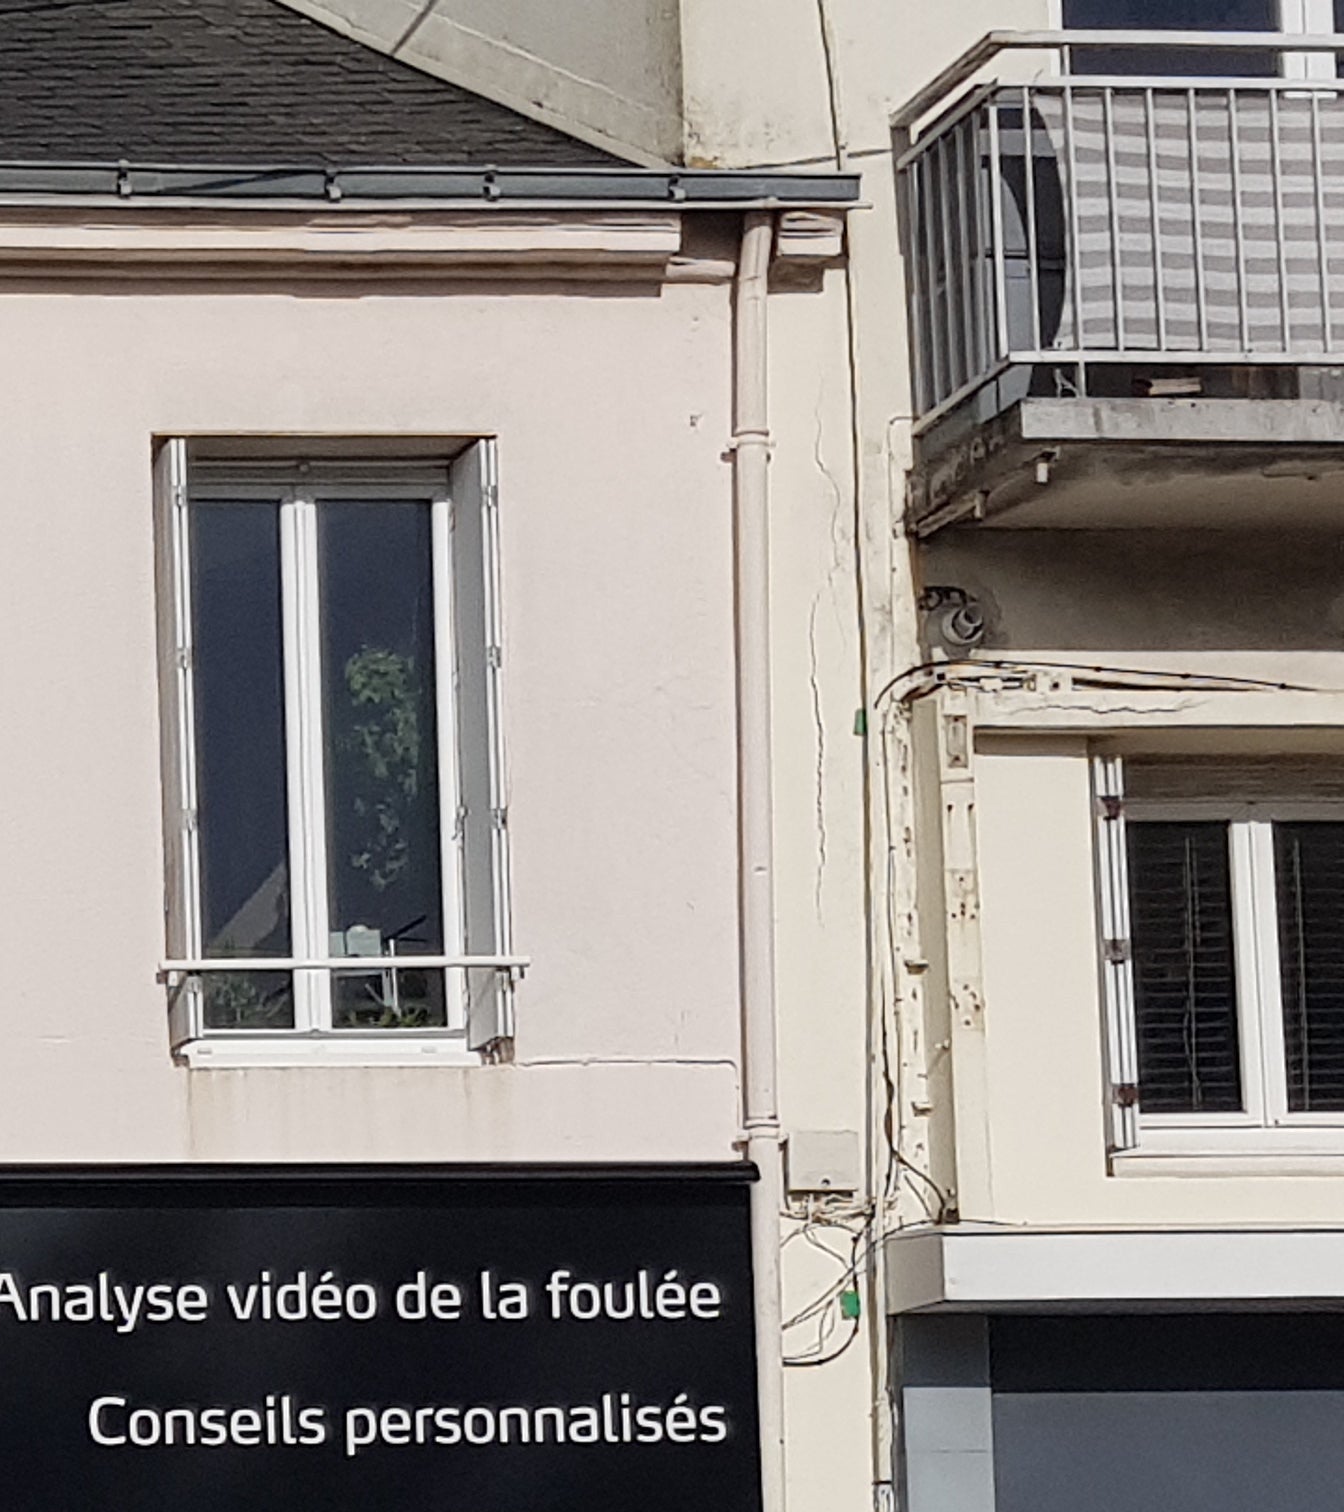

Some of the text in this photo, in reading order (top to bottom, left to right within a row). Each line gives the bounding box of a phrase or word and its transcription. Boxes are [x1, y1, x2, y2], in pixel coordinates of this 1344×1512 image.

[226, 1271, 377, 1321] vidéo
[395, 1271, 462, 1320] de
[481, 1271, 528, 1320] la
[546, 1270, 722, 1320] foulée
[88, 1393, 728, 1457] Conseils personnalisés
